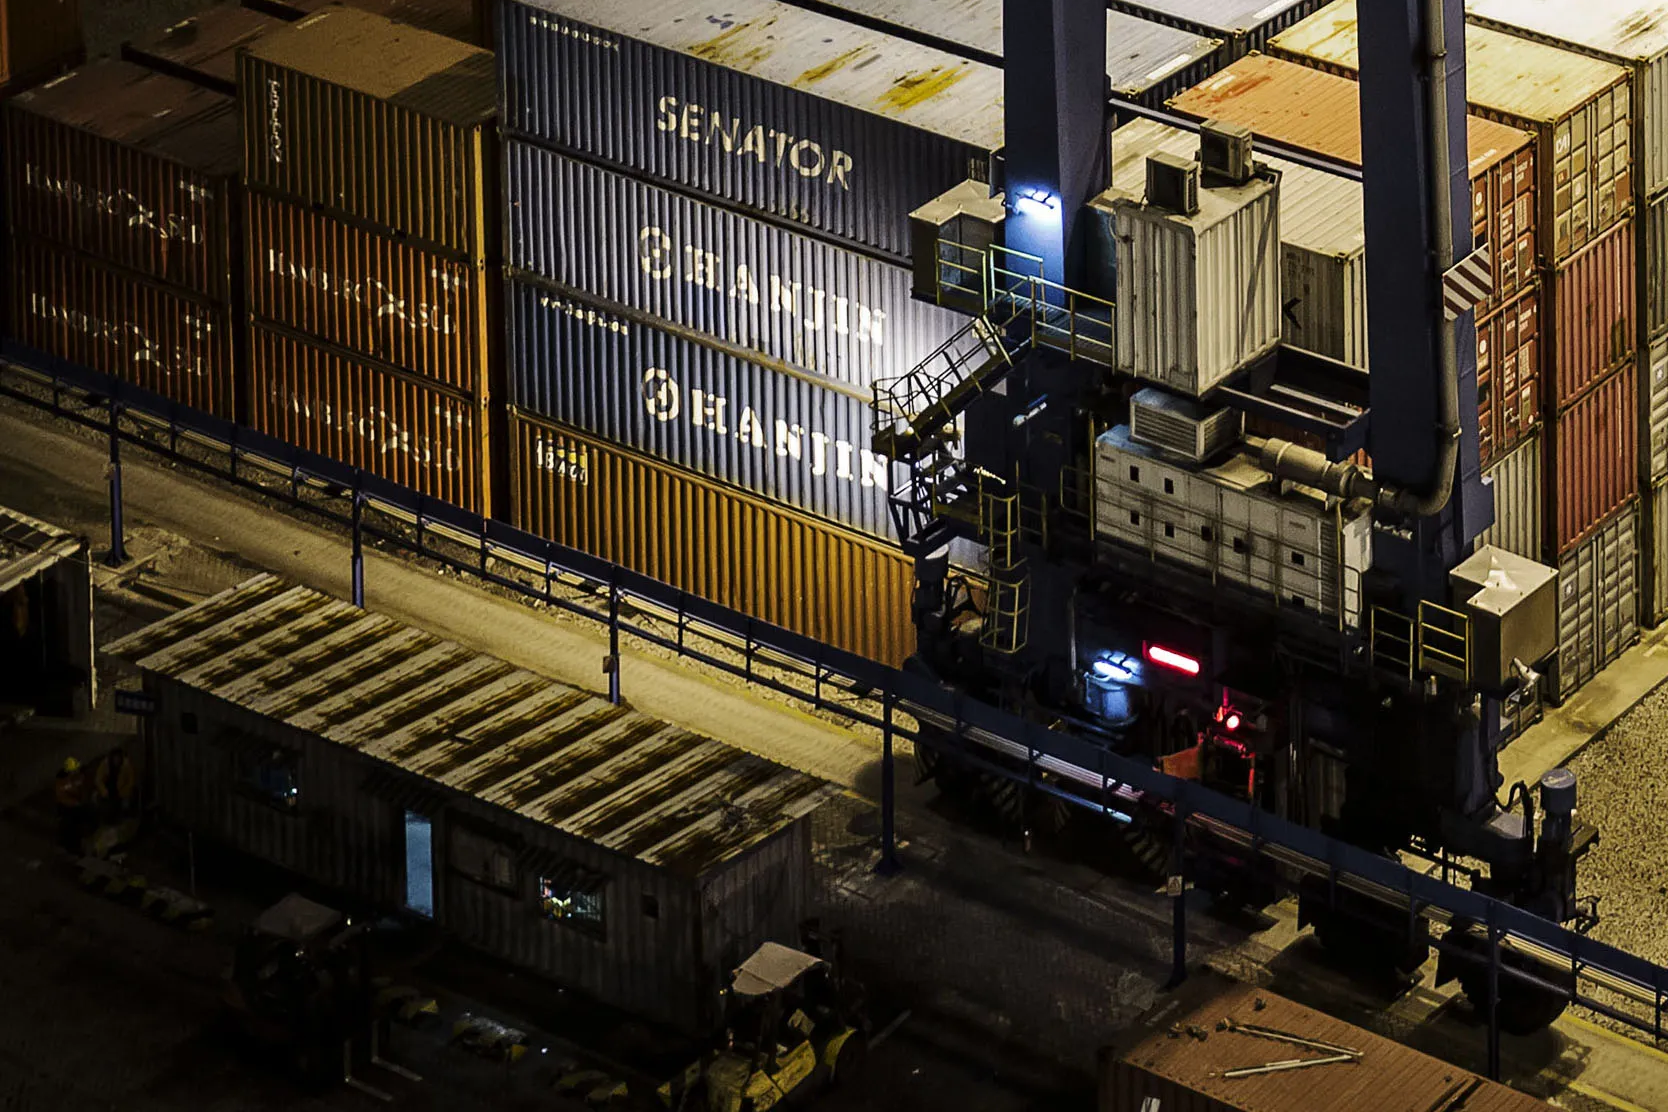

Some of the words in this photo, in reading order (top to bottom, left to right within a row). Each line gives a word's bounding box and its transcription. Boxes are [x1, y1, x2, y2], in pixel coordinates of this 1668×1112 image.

[657, 95, 854, 191] SENATOR
[685, 244, 887, 347] HANJIN
[691, 388, 889, 488] HANJIN
